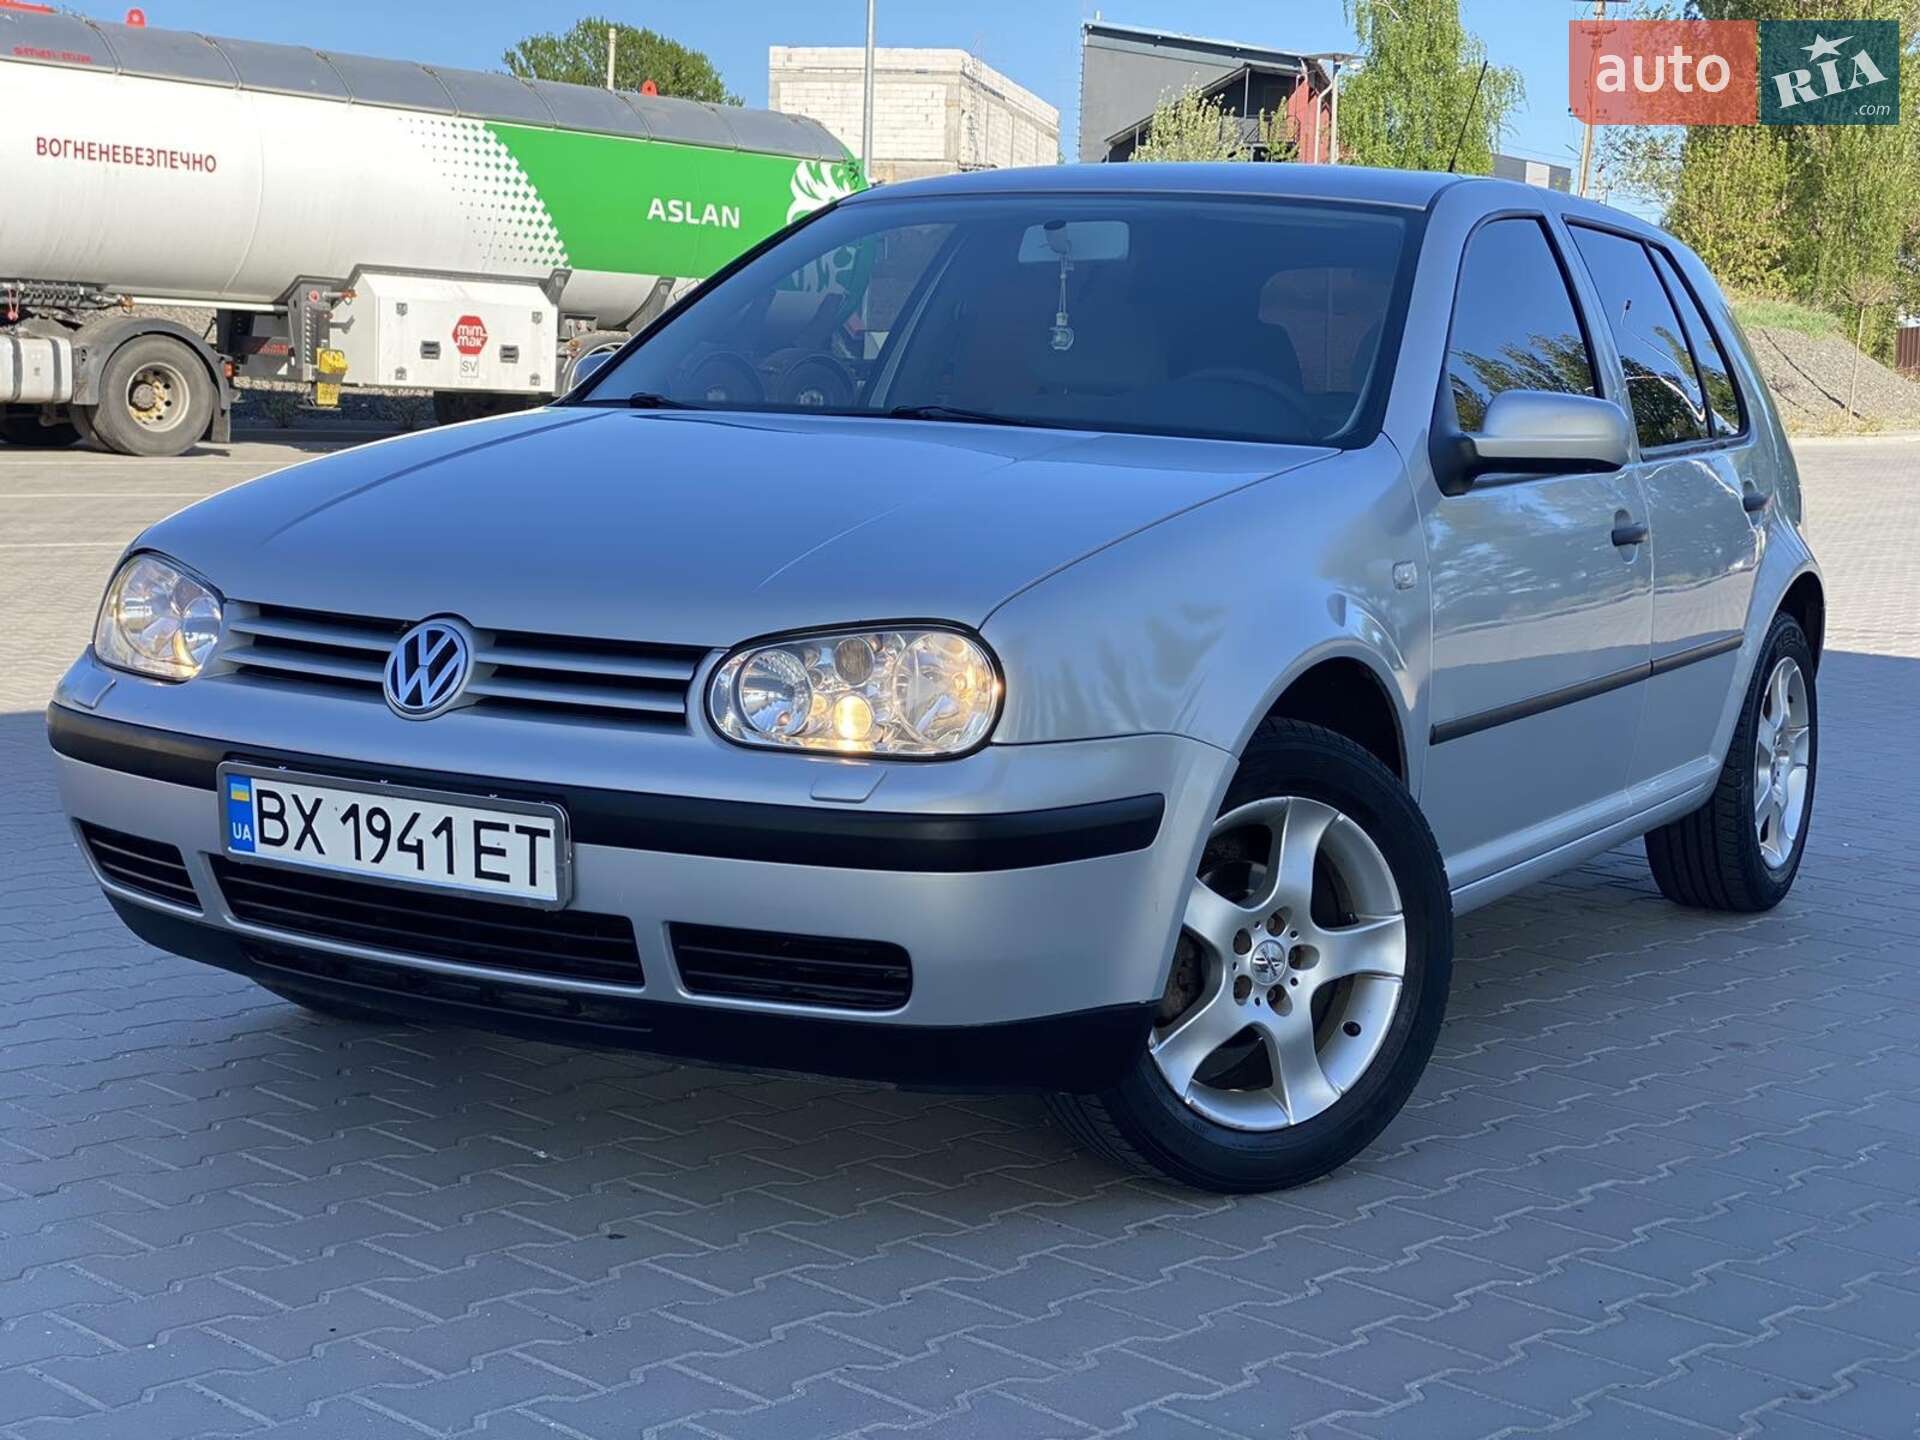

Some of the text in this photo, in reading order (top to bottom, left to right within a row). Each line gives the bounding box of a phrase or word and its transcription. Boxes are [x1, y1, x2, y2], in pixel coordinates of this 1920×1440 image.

[36, 136, 217, 173] ВОГНЕНЕБЕЗПЕЧНО
[647, 198, 740, 229] ASLAN
[462, 360, 477, 372] SV
[232, 821, 251, 842] UA
[255, 788, 551, 887] BX 1941 ET
